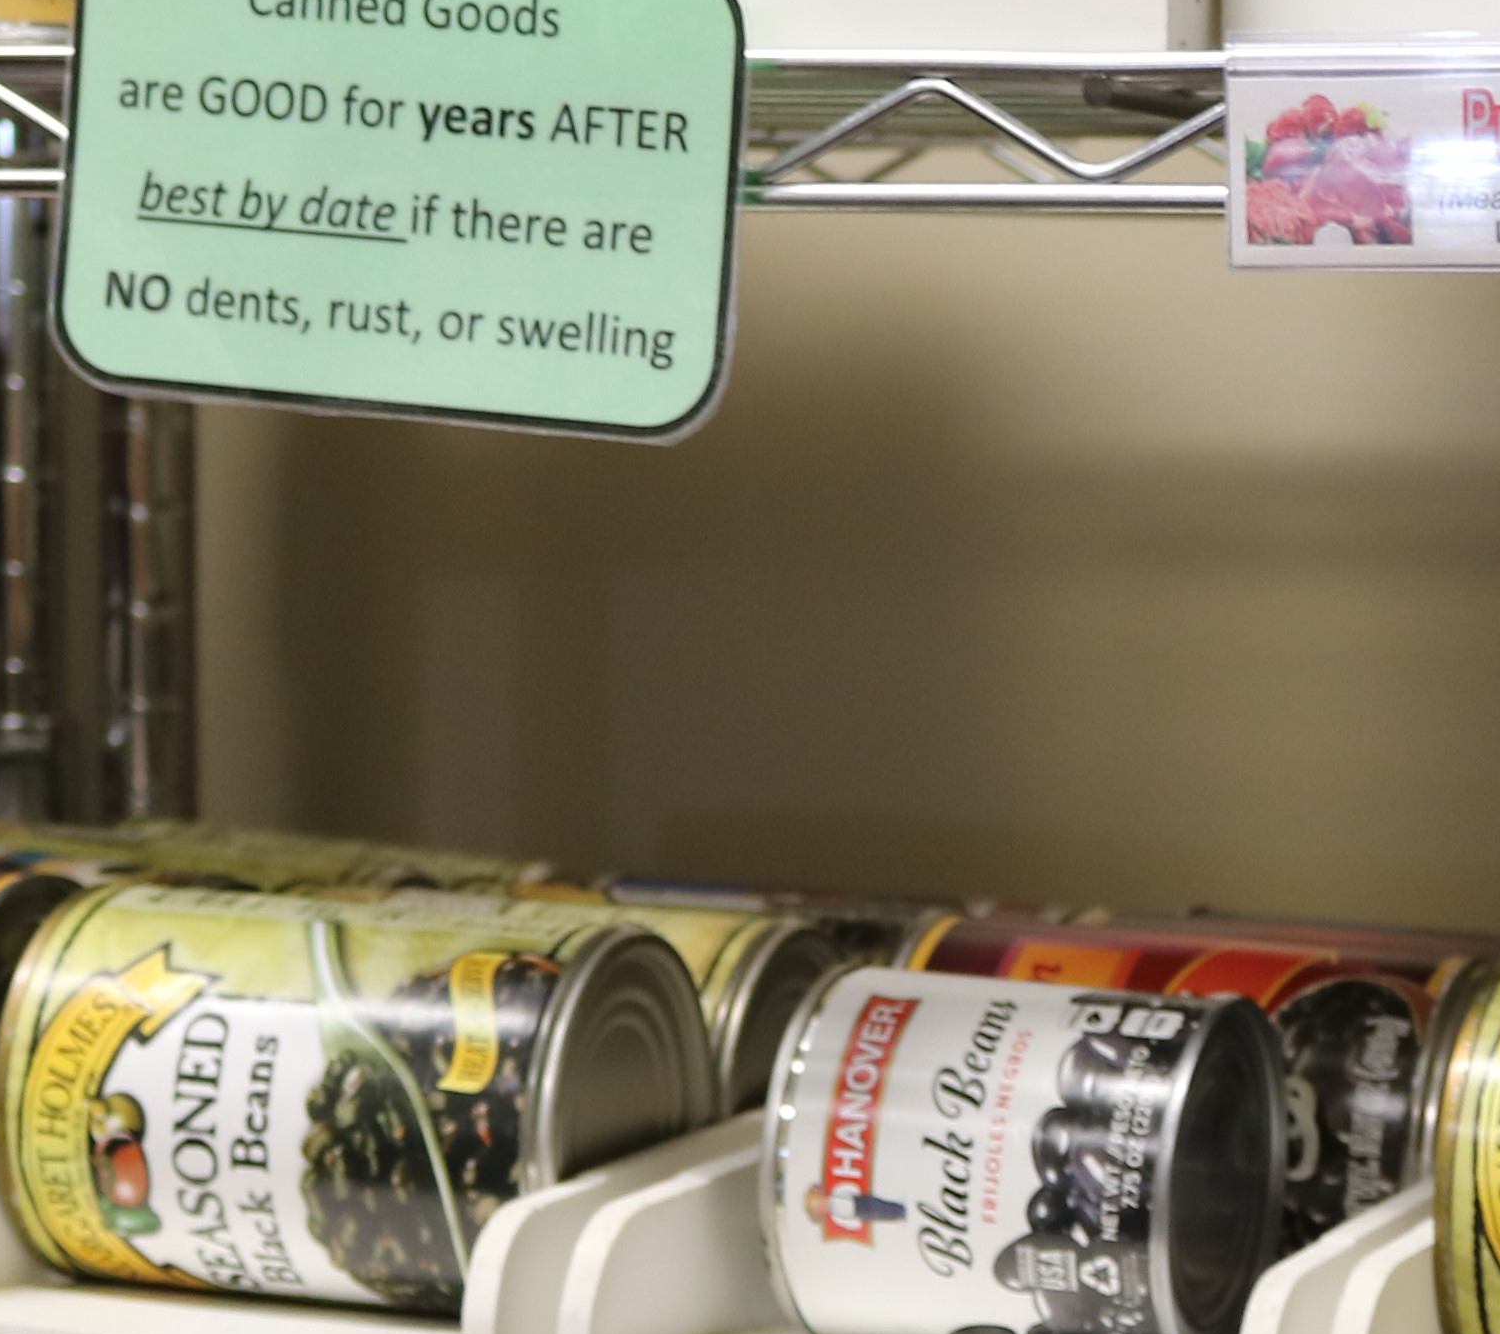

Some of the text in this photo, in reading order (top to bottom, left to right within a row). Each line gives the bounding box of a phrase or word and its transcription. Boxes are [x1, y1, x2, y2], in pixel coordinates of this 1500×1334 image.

[119, 76, 689, 151] are GOOD for years AFTER
[139, 171, 653, 253] best by date if there are
[105, 271, 675, 368] NO dents, rust, or swelling
[40, 993, 119, 1127] HOLMES
[831, 1003, 905, 1178] HANOVER
[917, 1001, 1018, 1277] Black Beans
[982, 1031, 1034, 1223] FRIJOLES NEGROS
[172, 1011, 257, 1291] SEASONED
[230, 1036, 302, 1284] Black Beans
